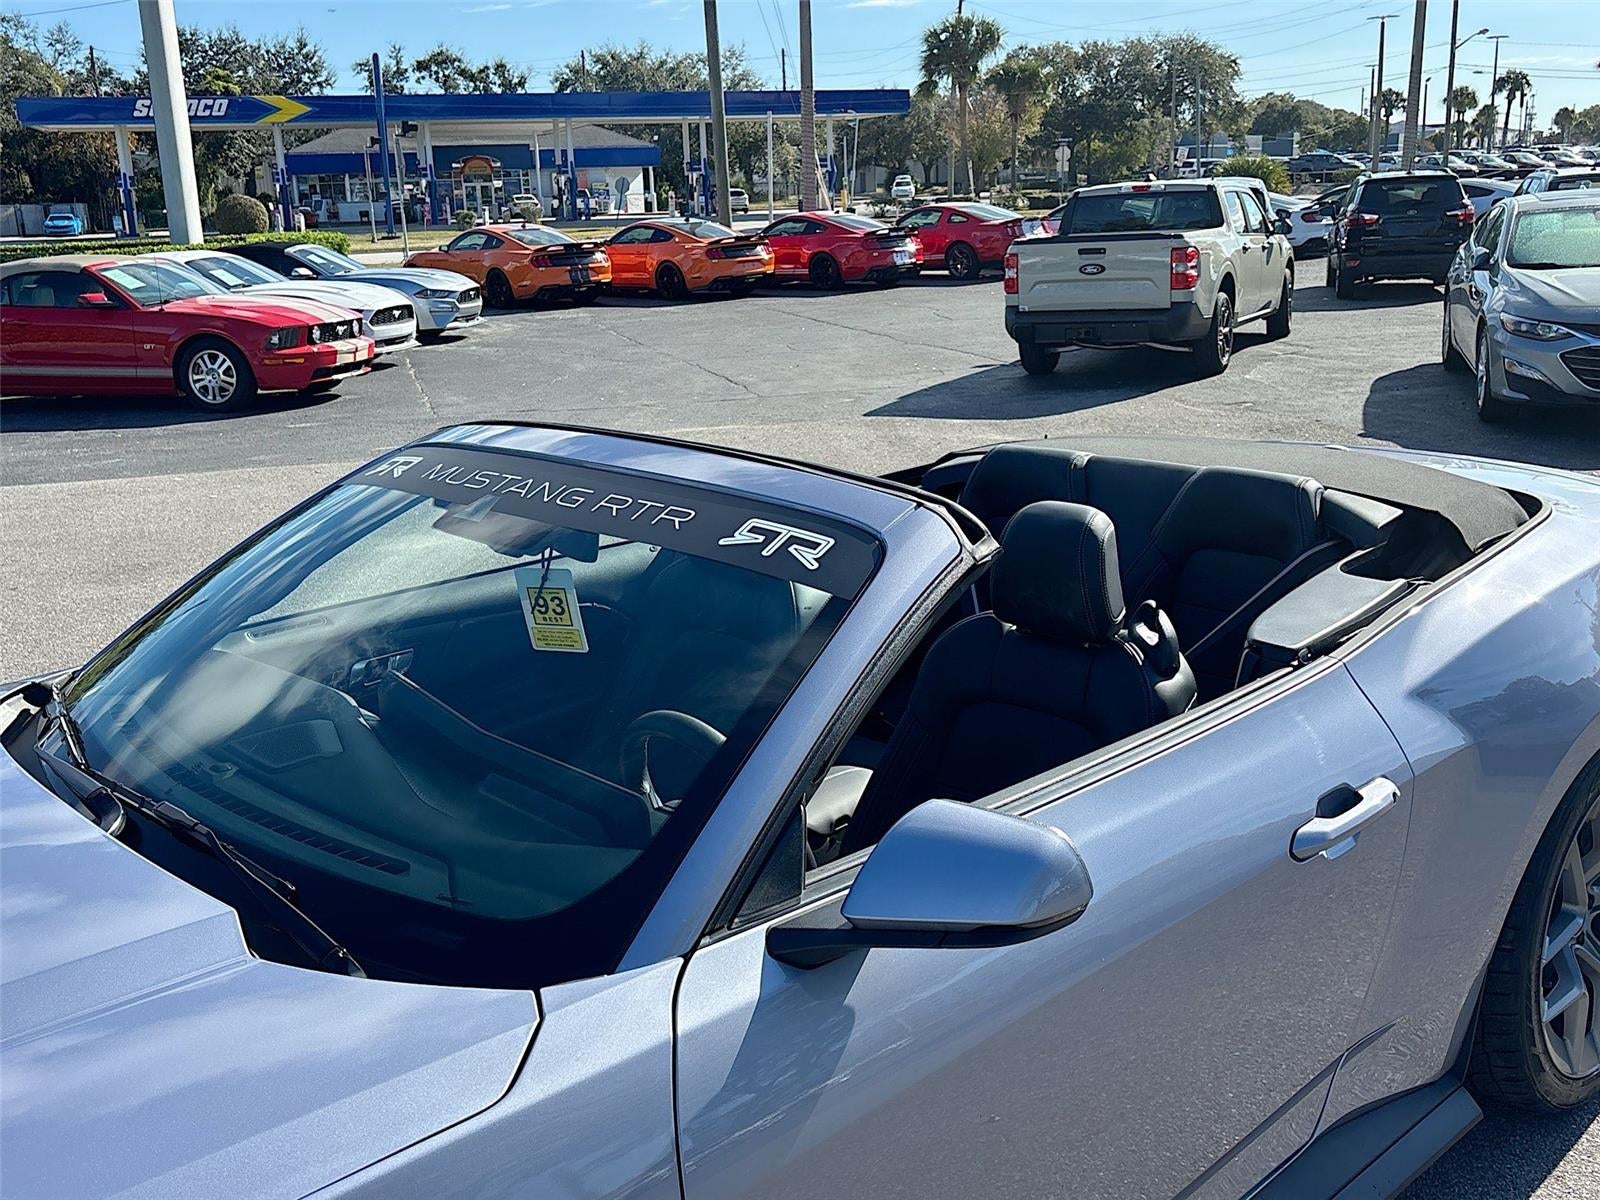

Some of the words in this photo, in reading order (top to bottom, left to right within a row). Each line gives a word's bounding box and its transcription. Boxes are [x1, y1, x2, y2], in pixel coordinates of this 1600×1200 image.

[420, 463, 595, 509] MUSTANG
[591, 493, 697, 530] RTR
[534, 595, 566, 616] 93
